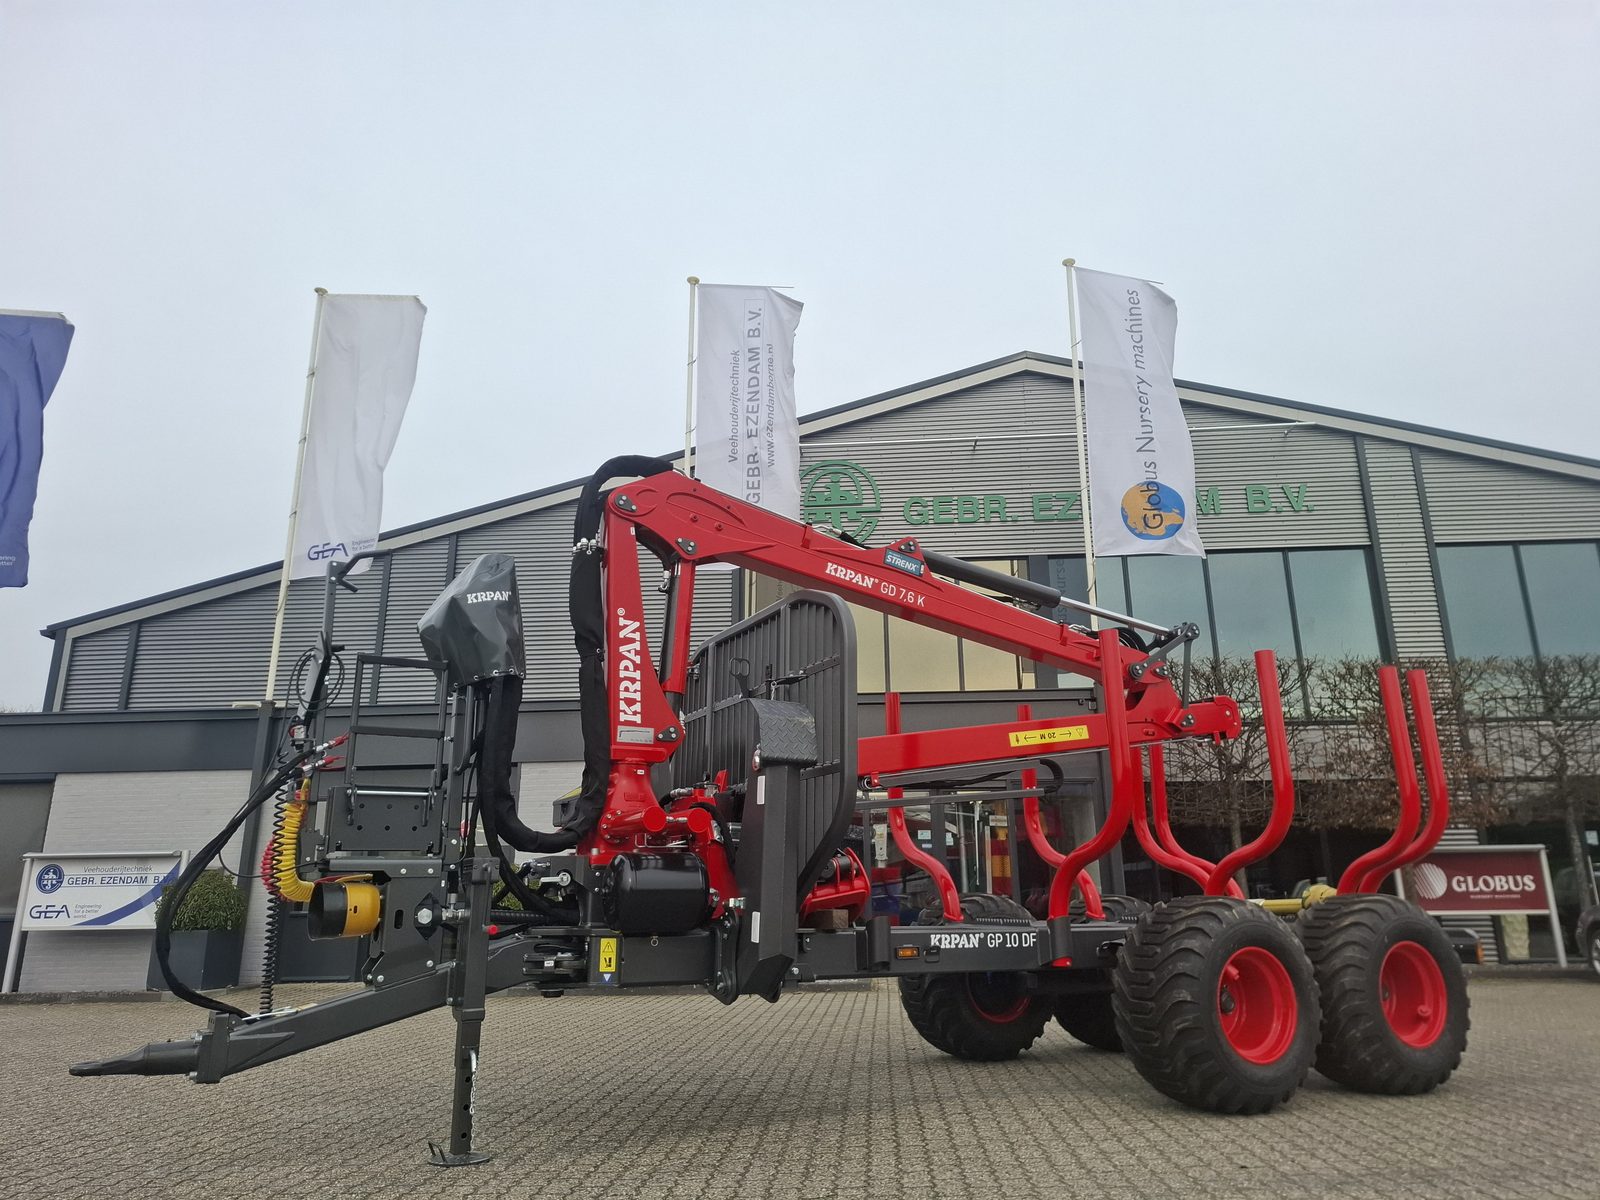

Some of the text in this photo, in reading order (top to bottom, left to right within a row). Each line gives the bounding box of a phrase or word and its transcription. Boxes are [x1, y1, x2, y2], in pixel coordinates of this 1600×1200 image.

[728, 349, 740, 464] Veehouderijtechniek
[746, 307, 762, 504] GEBR. EZENDAM B.V.
[766, 343, 776, 468] www.ezendamborne.nl
[1125, 288, 1164, 530] Globus Nursery machines
[903, 495, 1019, 525] GEBR.
[1245, 483, 1315, 513] B.V.
[307, 543, 349, 560] GEA
[886, 554, 918, 572] STRENX
[881, 582, 897, 597] GD
[917, 595, 926, 607] K
[83, 865, 153, 874] Veehouderijtechniek
[67, 877, 97, 885] GEBR.
[100, 876, 148, 885] EZENDAM
[1452, 874, 1536, 892] GLOBUS
[29, 904, 71, 919] GEA
[987, 933, 1004, 948] GP
[1006, 933, 1019, 948] 10
[1022, 932, 1037, 948] DF
